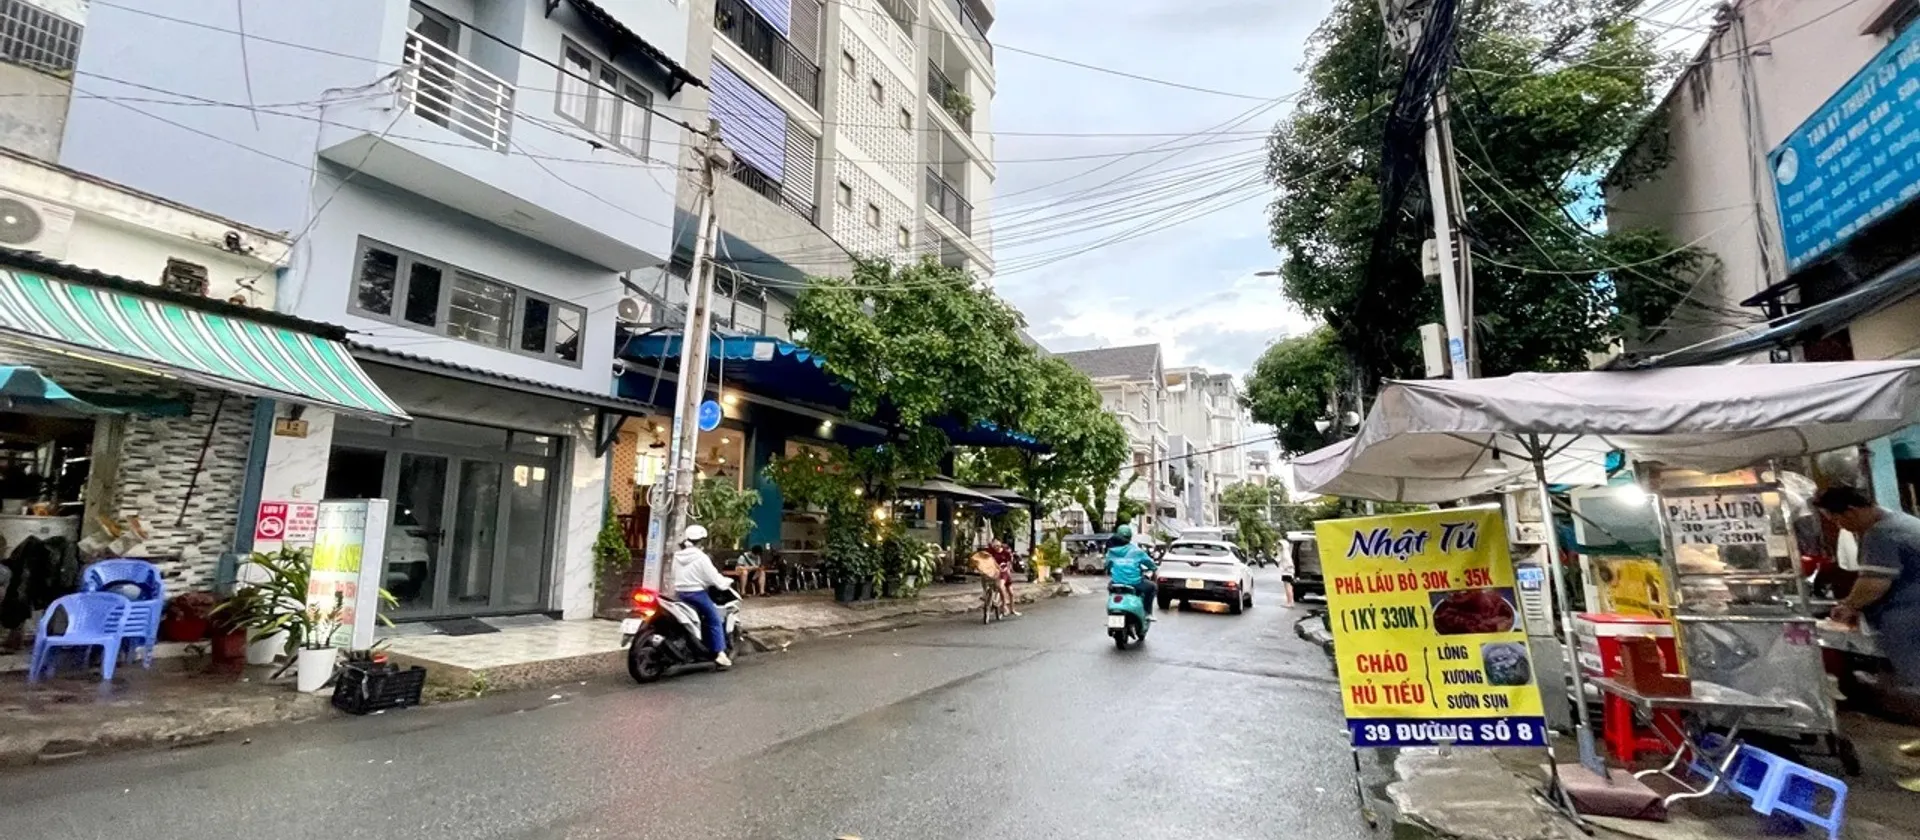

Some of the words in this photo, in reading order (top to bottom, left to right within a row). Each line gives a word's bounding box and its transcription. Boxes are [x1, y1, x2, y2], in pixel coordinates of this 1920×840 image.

[1346, 528, 1428, 561] Nhật
[1440, 521, 1478, 553] Tú
[1335, 573, 1364, 595] PHÁ
[1398, 568, 1418, 592] BÒ
[1421, 571, 1450, 589] 30K
[1464, 567, 1493, 586] 35K
[1356, 650, 1408, 673] CHÁO
[1437, 643, 1468, 660] LÒNG
[1442, 669, 1483, 684] XƯƠNG
[1351, 679, 1377, 704] HỦ
[1382, 678, 1425, 704] TIẾU
[1447, 691, 1480, 709] SƯỜN
[1484, 694, 1509, 712] SỤN
[1364, 723, 1391, 741] 39
[1396, 720, 1474, 741] ĐƯỜNG
[1480, 717, 1512, 741] SỐ
[1518, 722, 1533, 740] 8
